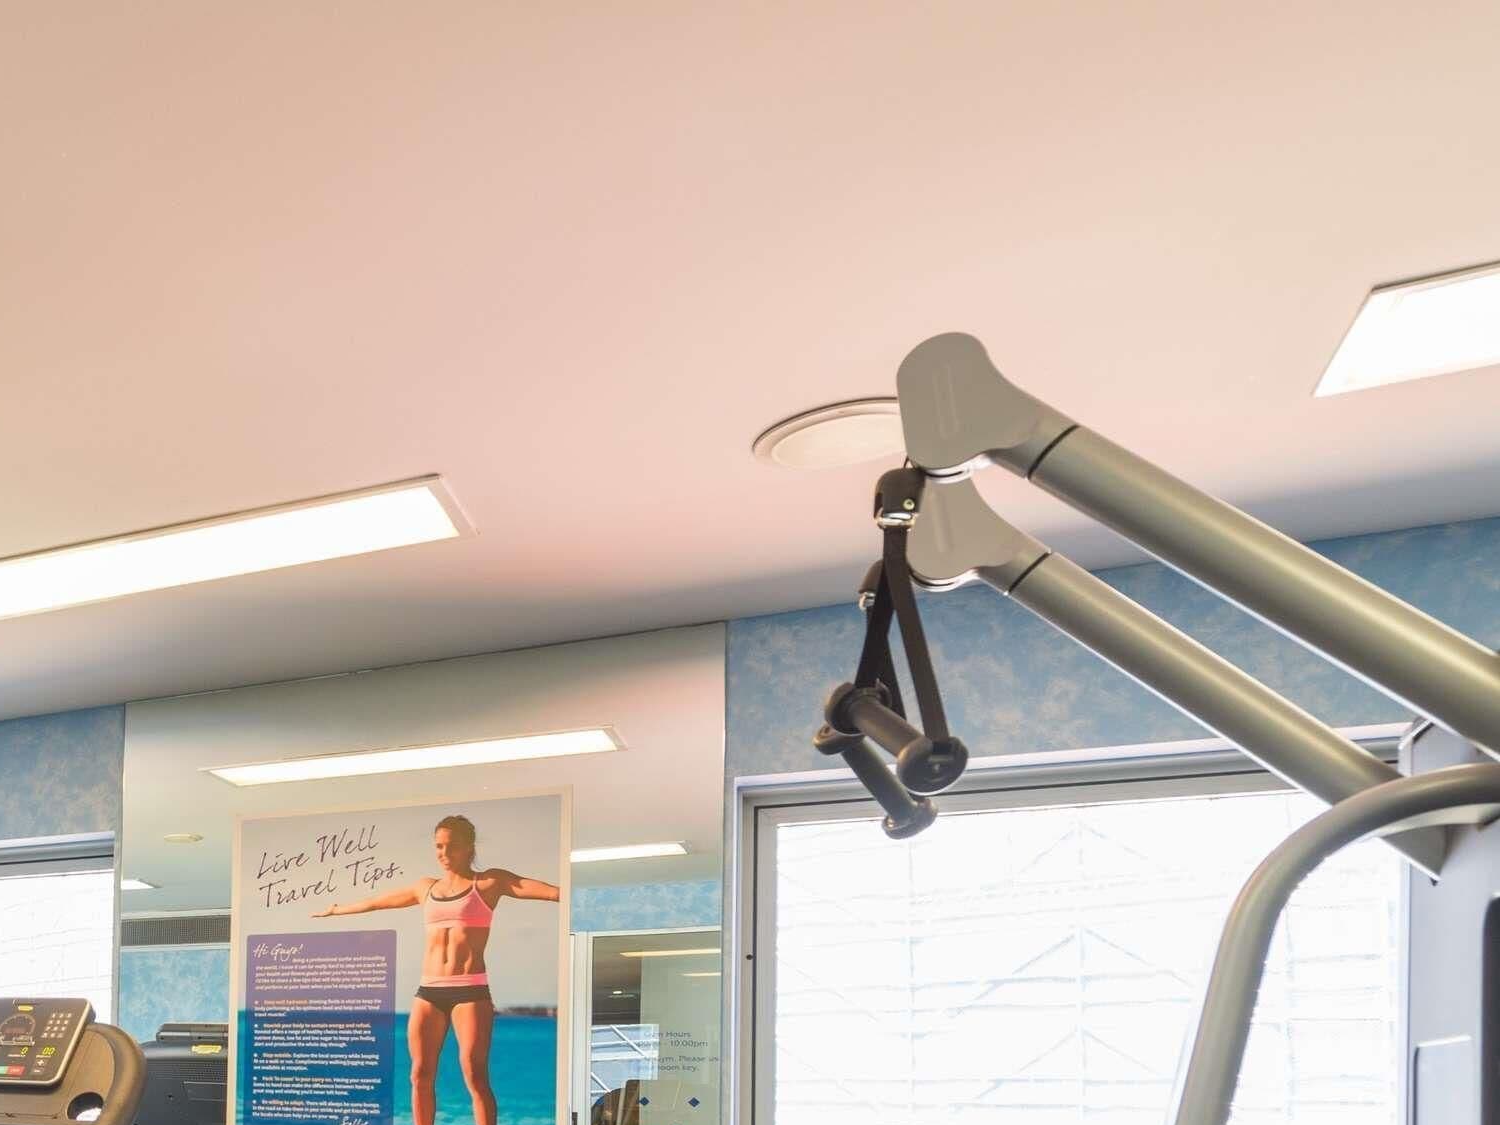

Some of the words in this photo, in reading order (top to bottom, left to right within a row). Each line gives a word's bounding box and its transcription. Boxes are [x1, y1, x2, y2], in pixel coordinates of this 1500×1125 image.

[257, 852, 310, 879] Live
[316, 825, 379, 863] Well
[259, 869, 338, 908] Travel
[345, 856, 404, 890] Tips.
[252, 943, 268, 959] Hi
[270, 943, 304, 962] Guys!
